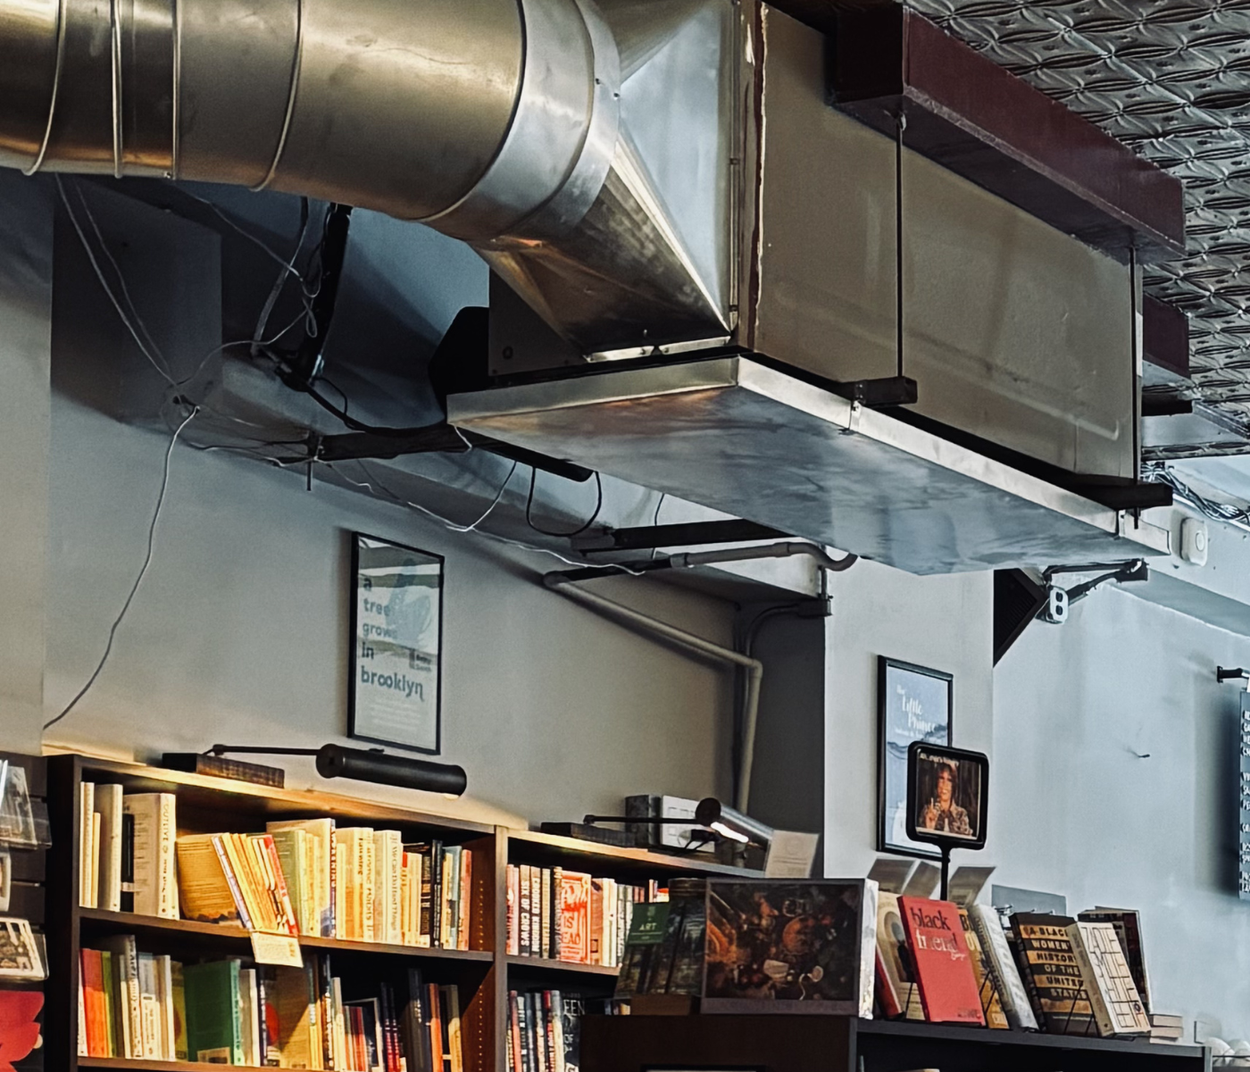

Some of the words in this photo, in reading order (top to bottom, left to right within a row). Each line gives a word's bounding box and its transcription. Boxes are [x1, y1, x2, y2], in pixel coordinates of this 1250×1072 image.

[363, 577, 373, 592] a
[363, 597, 391, 617] tree
[362, 621, 397, 642] grows
[361, 641, 374, 660] in
[360, 665, 425, 702] brooklyn
[902, 697, 923, 716] Little
[638, 922, 658, 931] ART
[910, 907, 950, 931] black
[1044, 964, 1058, 975] OF
[1059, 965, 1081, 976] THE
[1046, 975, 1084, 988] UNITED
